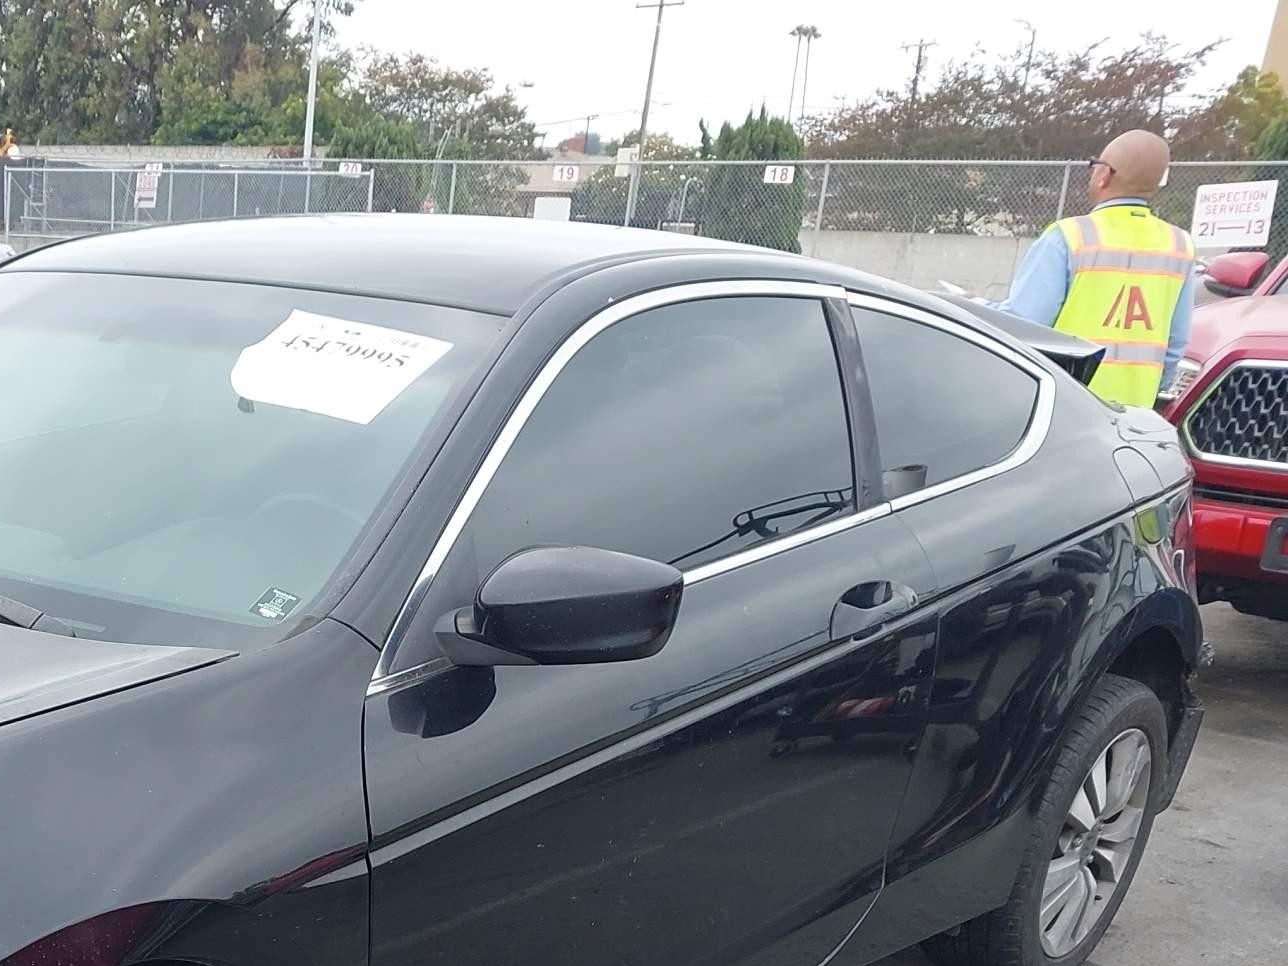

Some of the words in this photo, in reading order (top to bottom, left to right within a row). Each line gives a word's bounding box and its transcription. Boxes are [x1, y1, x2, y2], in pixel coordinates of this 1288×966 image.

[558, 167, 574, 180] 19
[770, 167, 789, 181] 18
[1200, 190, 1269, 203] INSPECTION
[1205, 202, 1261, 215] SERVICES
